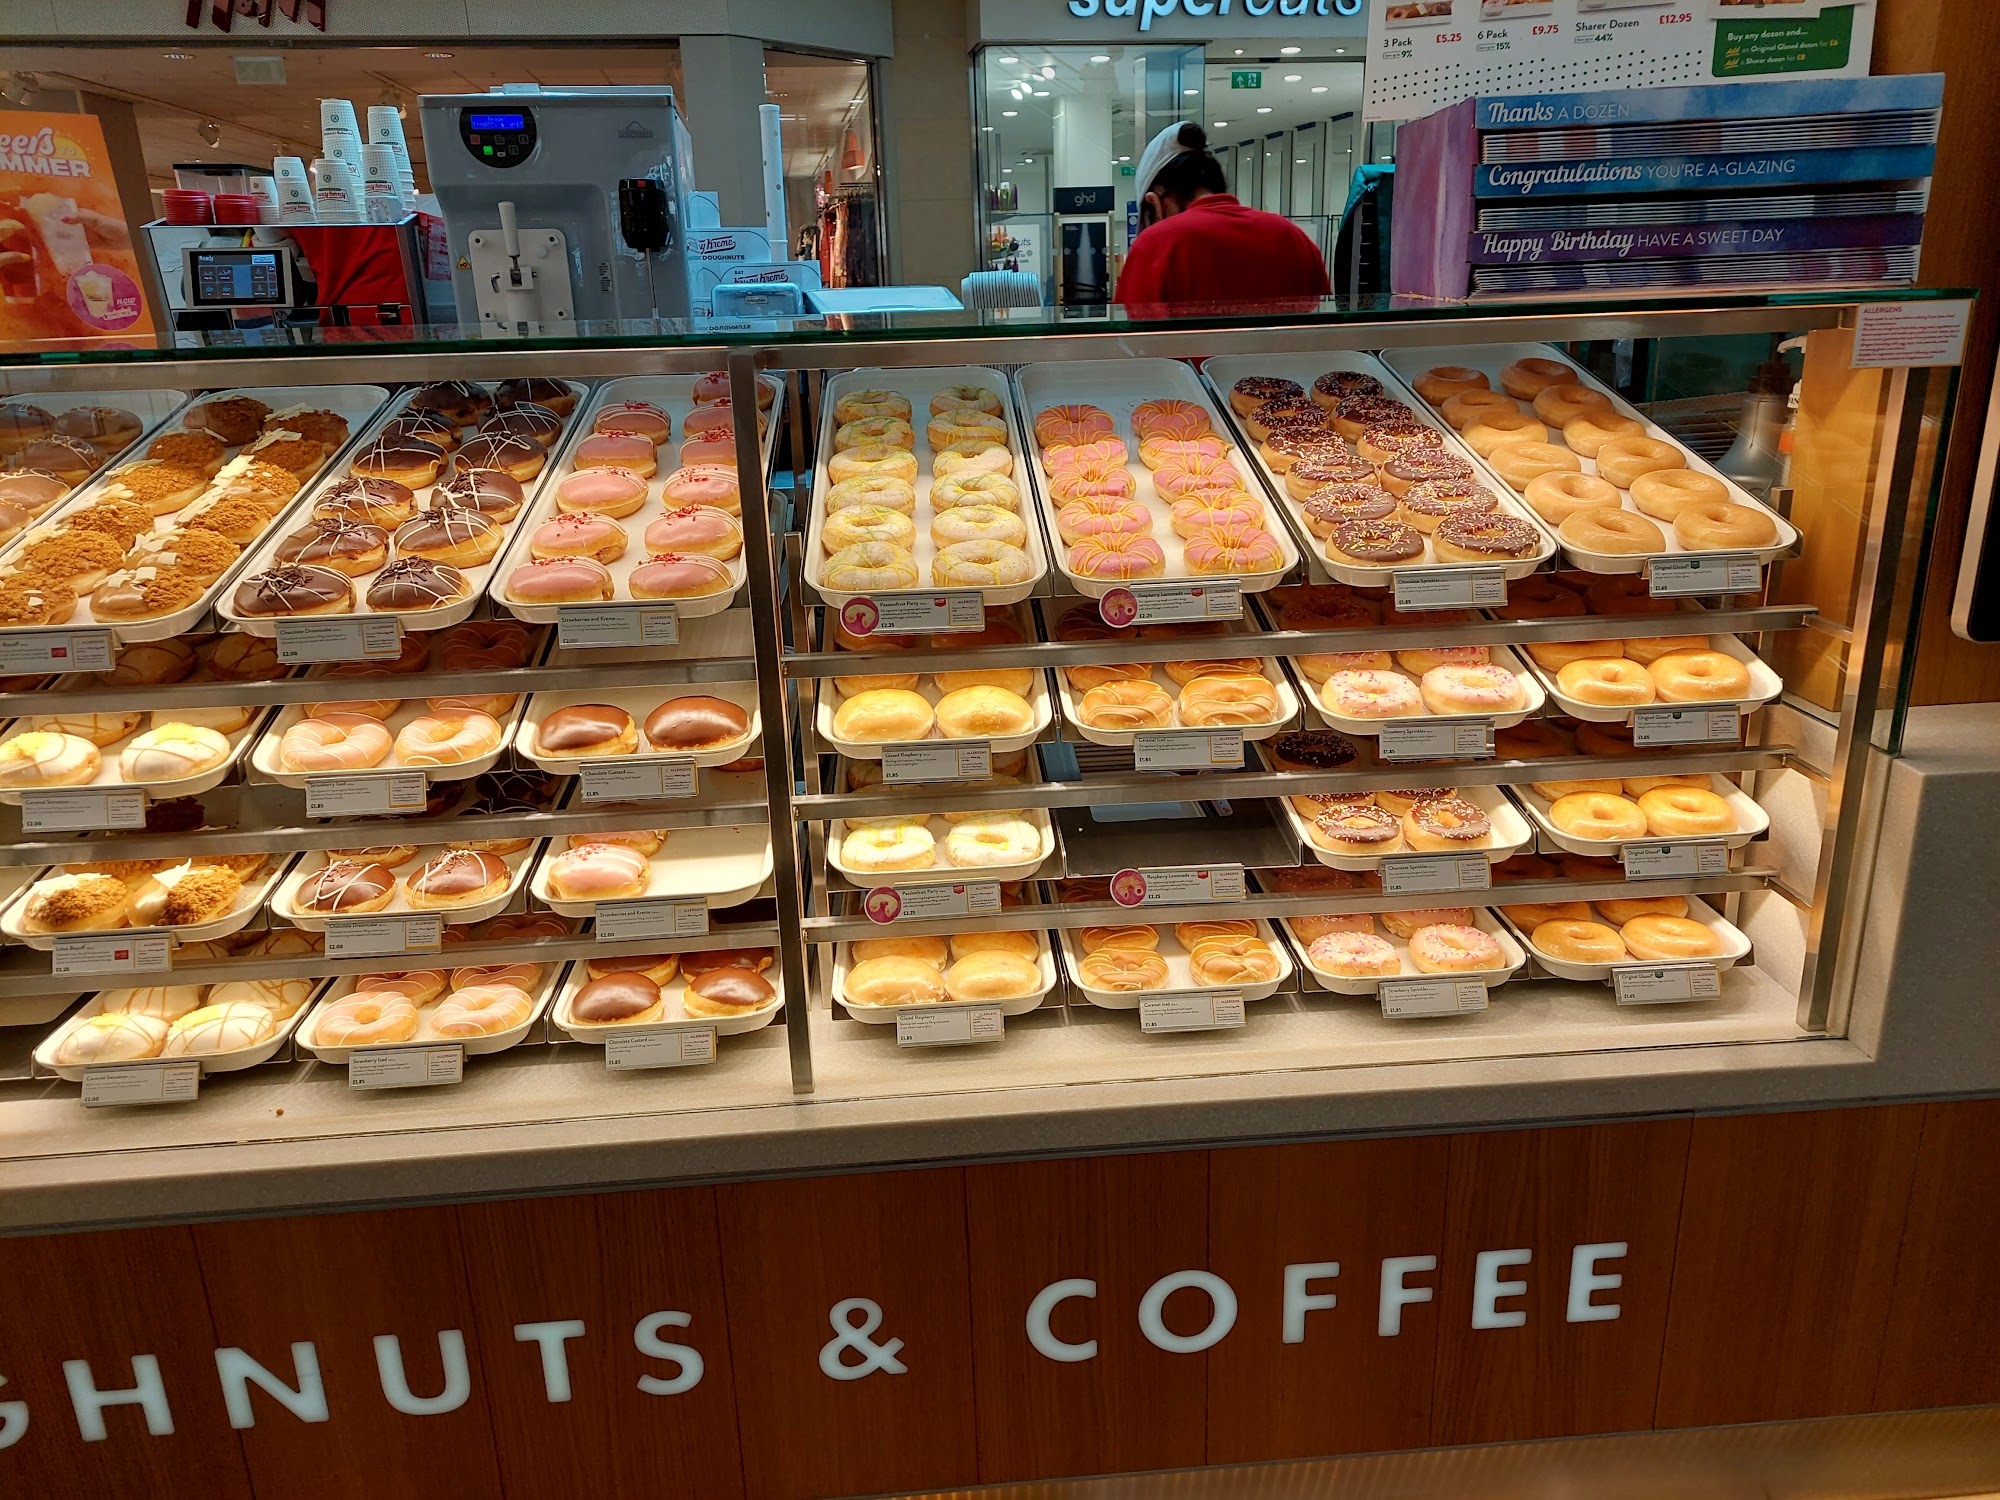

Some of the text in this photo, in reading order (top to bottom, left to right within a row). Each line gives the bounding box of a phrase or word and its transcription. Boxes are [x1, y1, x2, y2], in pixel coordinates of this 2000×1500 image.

[1659, 12, 1693, 25] £12.95
[1532, 24, 1559, 35] £9.75
[1575, 19, 1640, 32] Sharer Dozen
[1436, 32, 1462, 44] £5.25
[1477, 28, 1509, 40] 6 Pack
[1594, 33, 1613, 42] 44%
[1727, 32, 1744, 43] Buy
[1744, 33, 1760, 42] any
[1760, 30, 1785, 39] dozen
[1383, 36, 1413, 48] 3 Pack
[1496, 41, 1511, 51] 15%
[1401, 49, 1413, 58] 9%
[1487, 101, 1630, 124] Thanks A DOZEN
[1488, 158, 1796, 195] Congratulations YOU'RE A-GLAZING
[1073, 191, 1097, 207] ghd
[1482, 227, 1785, 262] Happy Birthday HAVE A SWEET DAY
[1863, 306, 1902, 314] ALLERGENS
[818, 1296, 909, 1381] &
[1025, 1241, 1628, 1363] COFFEE
